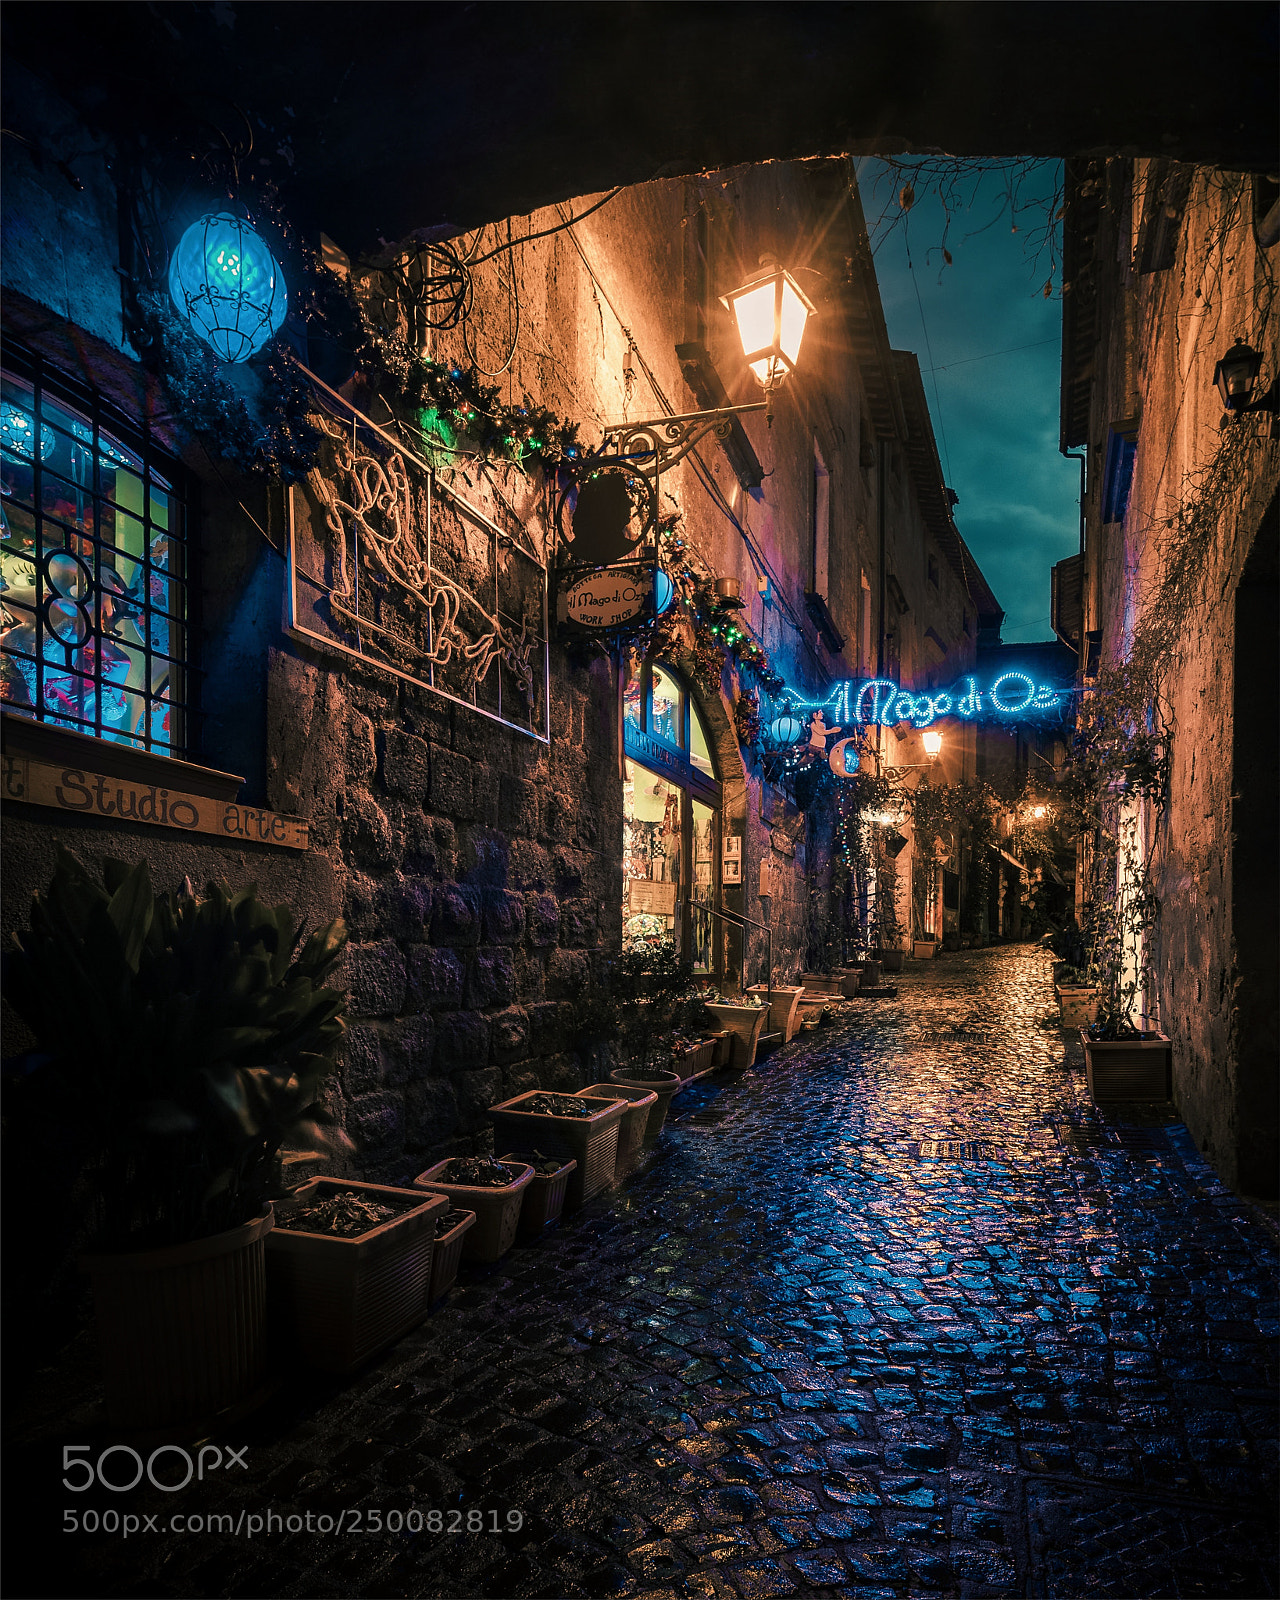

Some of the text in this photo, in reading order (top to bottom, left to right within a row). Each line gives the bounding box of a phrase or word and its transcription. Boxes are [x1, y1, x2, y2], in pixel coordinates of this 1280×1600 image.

[572, 573, 603, 592] BOTTEGA
[578, 591, 611, 607] Mago
[612, 589, 621, 603] di
[622, 587, 642, 602] Oz
[579, 608, 632, 625] WORK SHOP
[855, 680, 953, 728] Mago
[958, 677, 984, 716] di
[55, 769, 200, 829] Studio
[223, 804, 287, 842] arte
